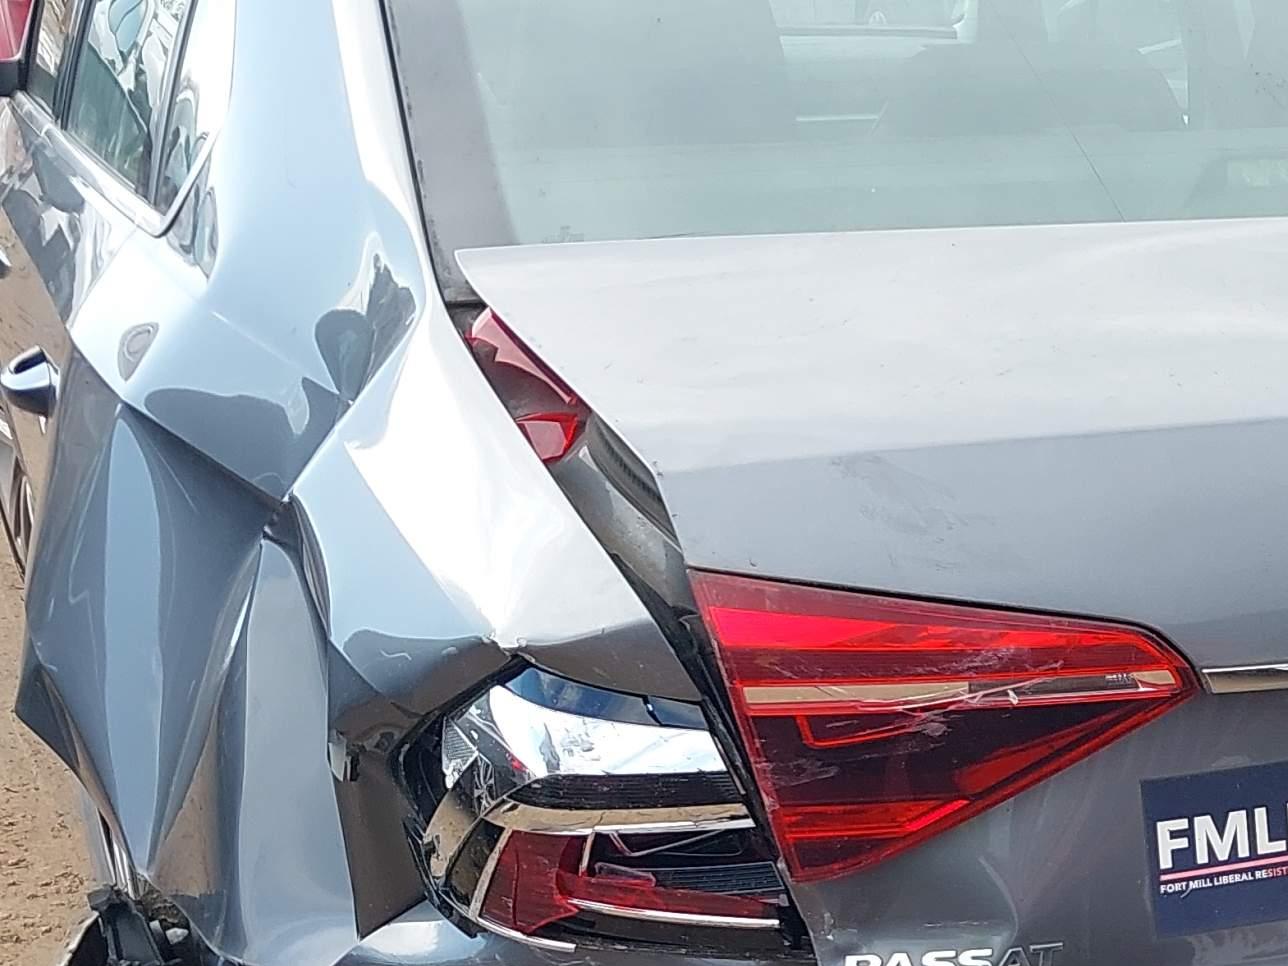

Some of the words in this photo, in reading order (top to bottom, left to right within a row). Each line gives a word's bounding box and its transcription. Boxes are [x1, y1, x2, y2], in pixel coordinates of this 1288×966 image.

[1159, 881, 1188, 894] FORT
[1188, 878, 1213, 890] MILL
[1213, 872, 1254, 887] LIBERAL
